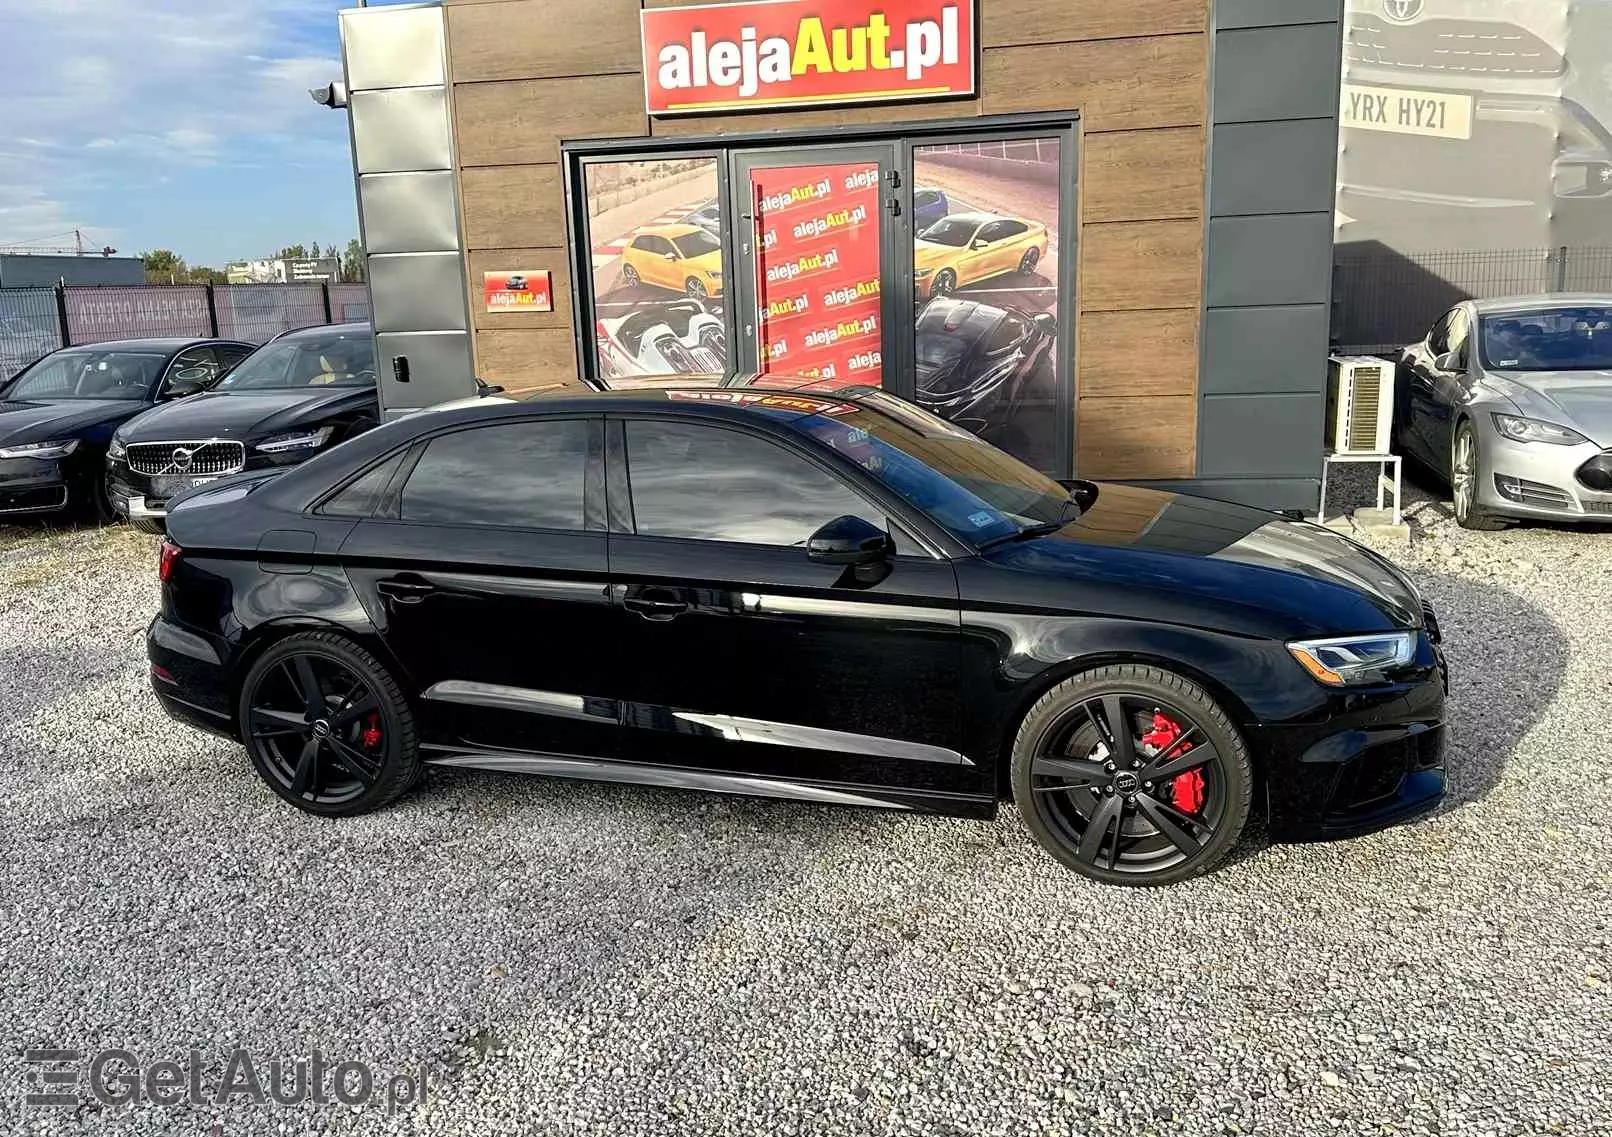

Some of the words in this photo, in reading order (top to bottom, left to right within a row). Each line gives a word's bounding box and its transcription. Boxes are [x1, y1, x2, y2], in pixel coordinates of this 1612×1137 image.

[658, 6, 959, 97] alejaAut.pl
[1350, 92, 1388, 124] YRX
[1398, 97, 1446, 130] HY21
[844, 168, 879, 189] aleja
[759, 178, 832, 212] alejaAut.pl
[793, 205, 866, 238] alejaAut.pl
[767, 249, 838, 281] alejaAut.pl
[490, 291, 547, 306] alejaAut.pl
[823, 279, 880, 306] alejaAut
[803, 315, 877, 347] alejaAut.pl
[847, 350, 881, 370] aleja
